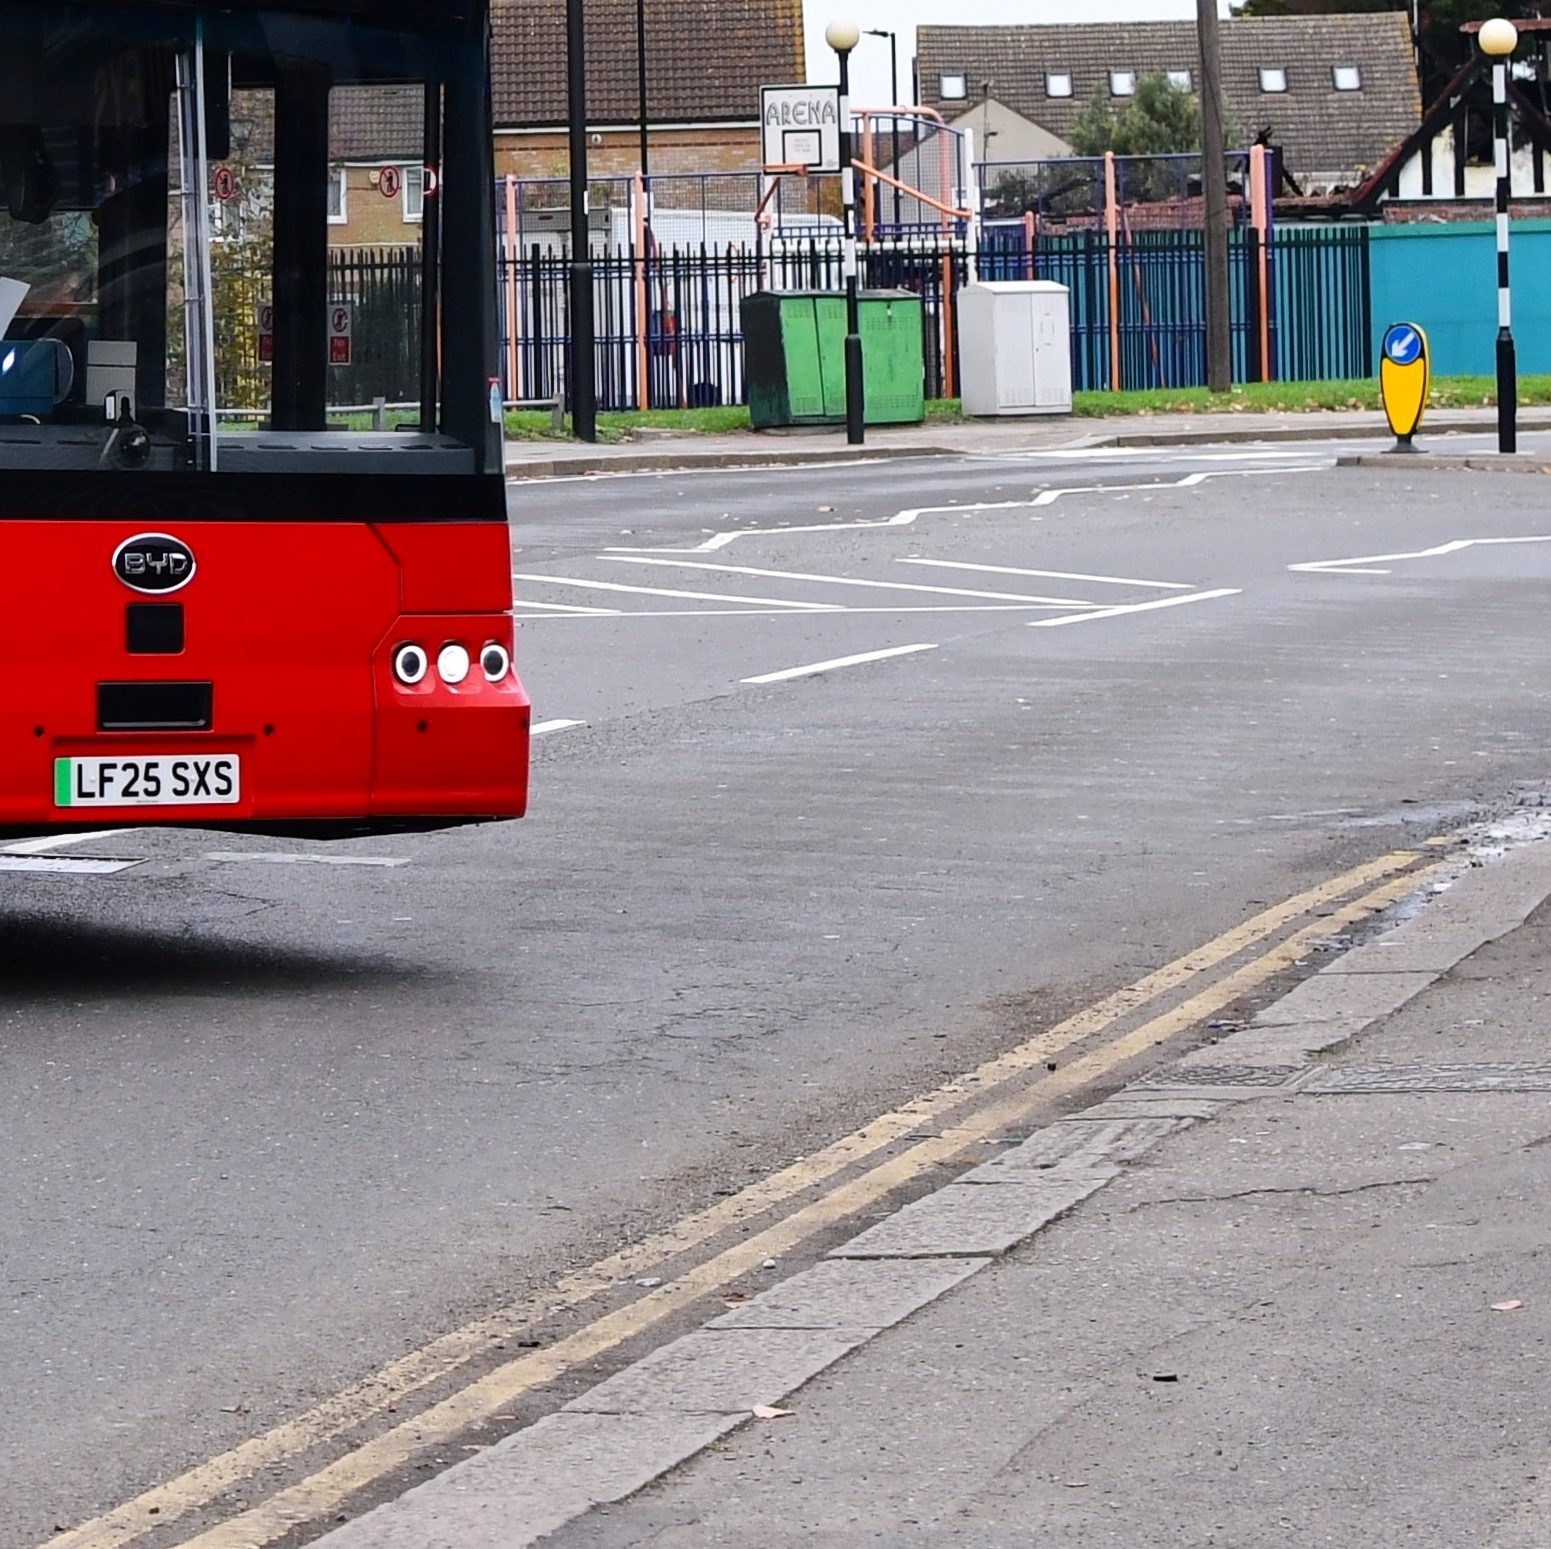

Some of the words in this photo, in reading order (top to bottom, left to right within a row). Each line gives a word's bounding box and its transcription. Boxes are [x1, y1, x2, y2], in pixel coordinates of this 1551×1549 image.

[766, 100, 836, 126] ARENA
[124, 552, 188, 575] BYD
[77, 762, 161, 798] LF25
[172, 760, 233, 797] SXS
